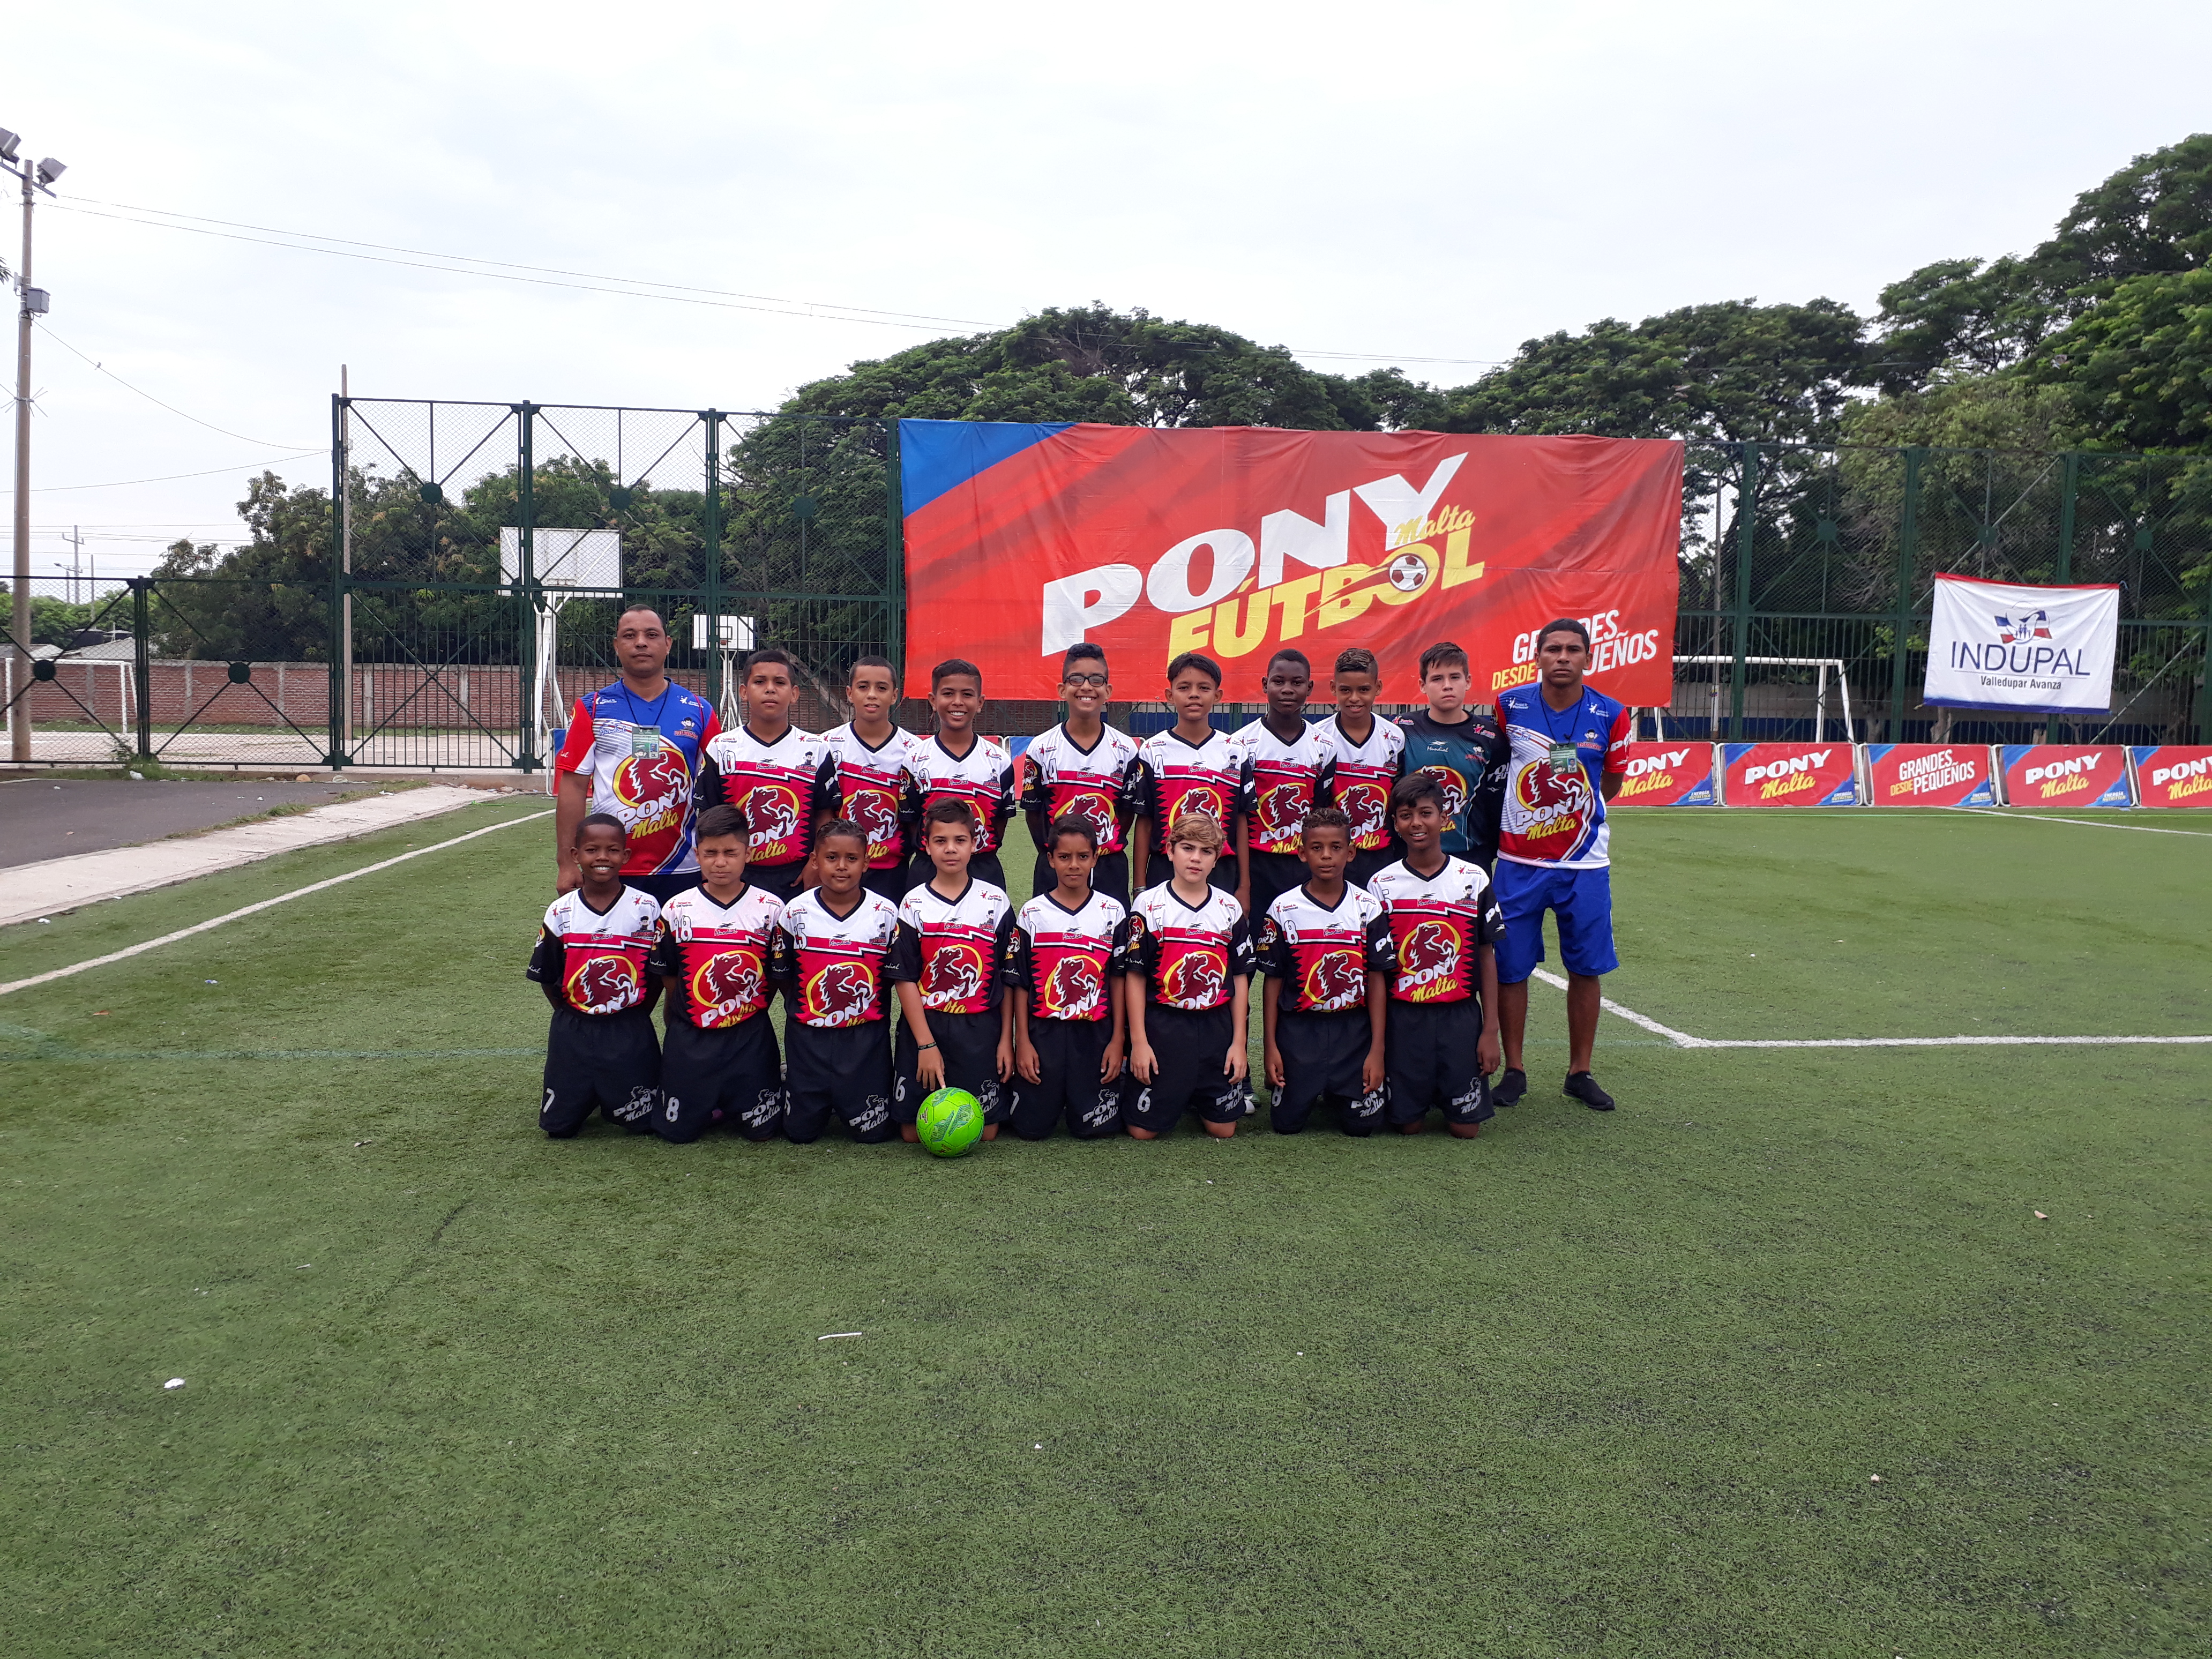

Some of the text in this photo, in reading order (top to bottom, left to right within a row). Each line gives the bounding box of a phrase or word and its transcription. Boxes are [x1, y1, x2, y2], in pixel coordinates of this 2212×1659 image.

[1394, 504, 1477, 546] Malta
[1042, 452, 1469, 657] PONY
[1166, 526, 1485, 678] FÚTBOL
[1951, 641, 2090, 676] INDUPAL
[1491, 662, 1536, 691] DESDE
[1981, 676, 2061, 690] Valledupar Avanza
[718, 750, 736, 776] 10
[1625, 748, 1691, 776] ONY
[1745, 749, 1833, 785] PONY
[1899, 749, 1953, 781] GRANDES
[2025, 752, 2103, 785] PONY
[2153, 756, 2212, 786] PON
[913, 768, 932, 795] 13
[1619, 771, 1673, 798] Malta
[1760, 772, 1816, 799] Malta
[1889, 760, 1976, 797] DESDE PEQUEÑOS
[2040, 773, 2089, 799] Malta
[631, 809, 679, 840] Malta
[749, 819, 800, 847] ONY
[1259, 816, 1304, 845] PON
[1526, 816, 1577, 841] Malta
[1271, 834, 1304, 854] Malt
[674, 915, 693, 944] 18
[1398, 955, 1462, 993] PONY
[1410, 977, 1459, 1003] Malta
[859, 1111, 890, 1133] Malta
